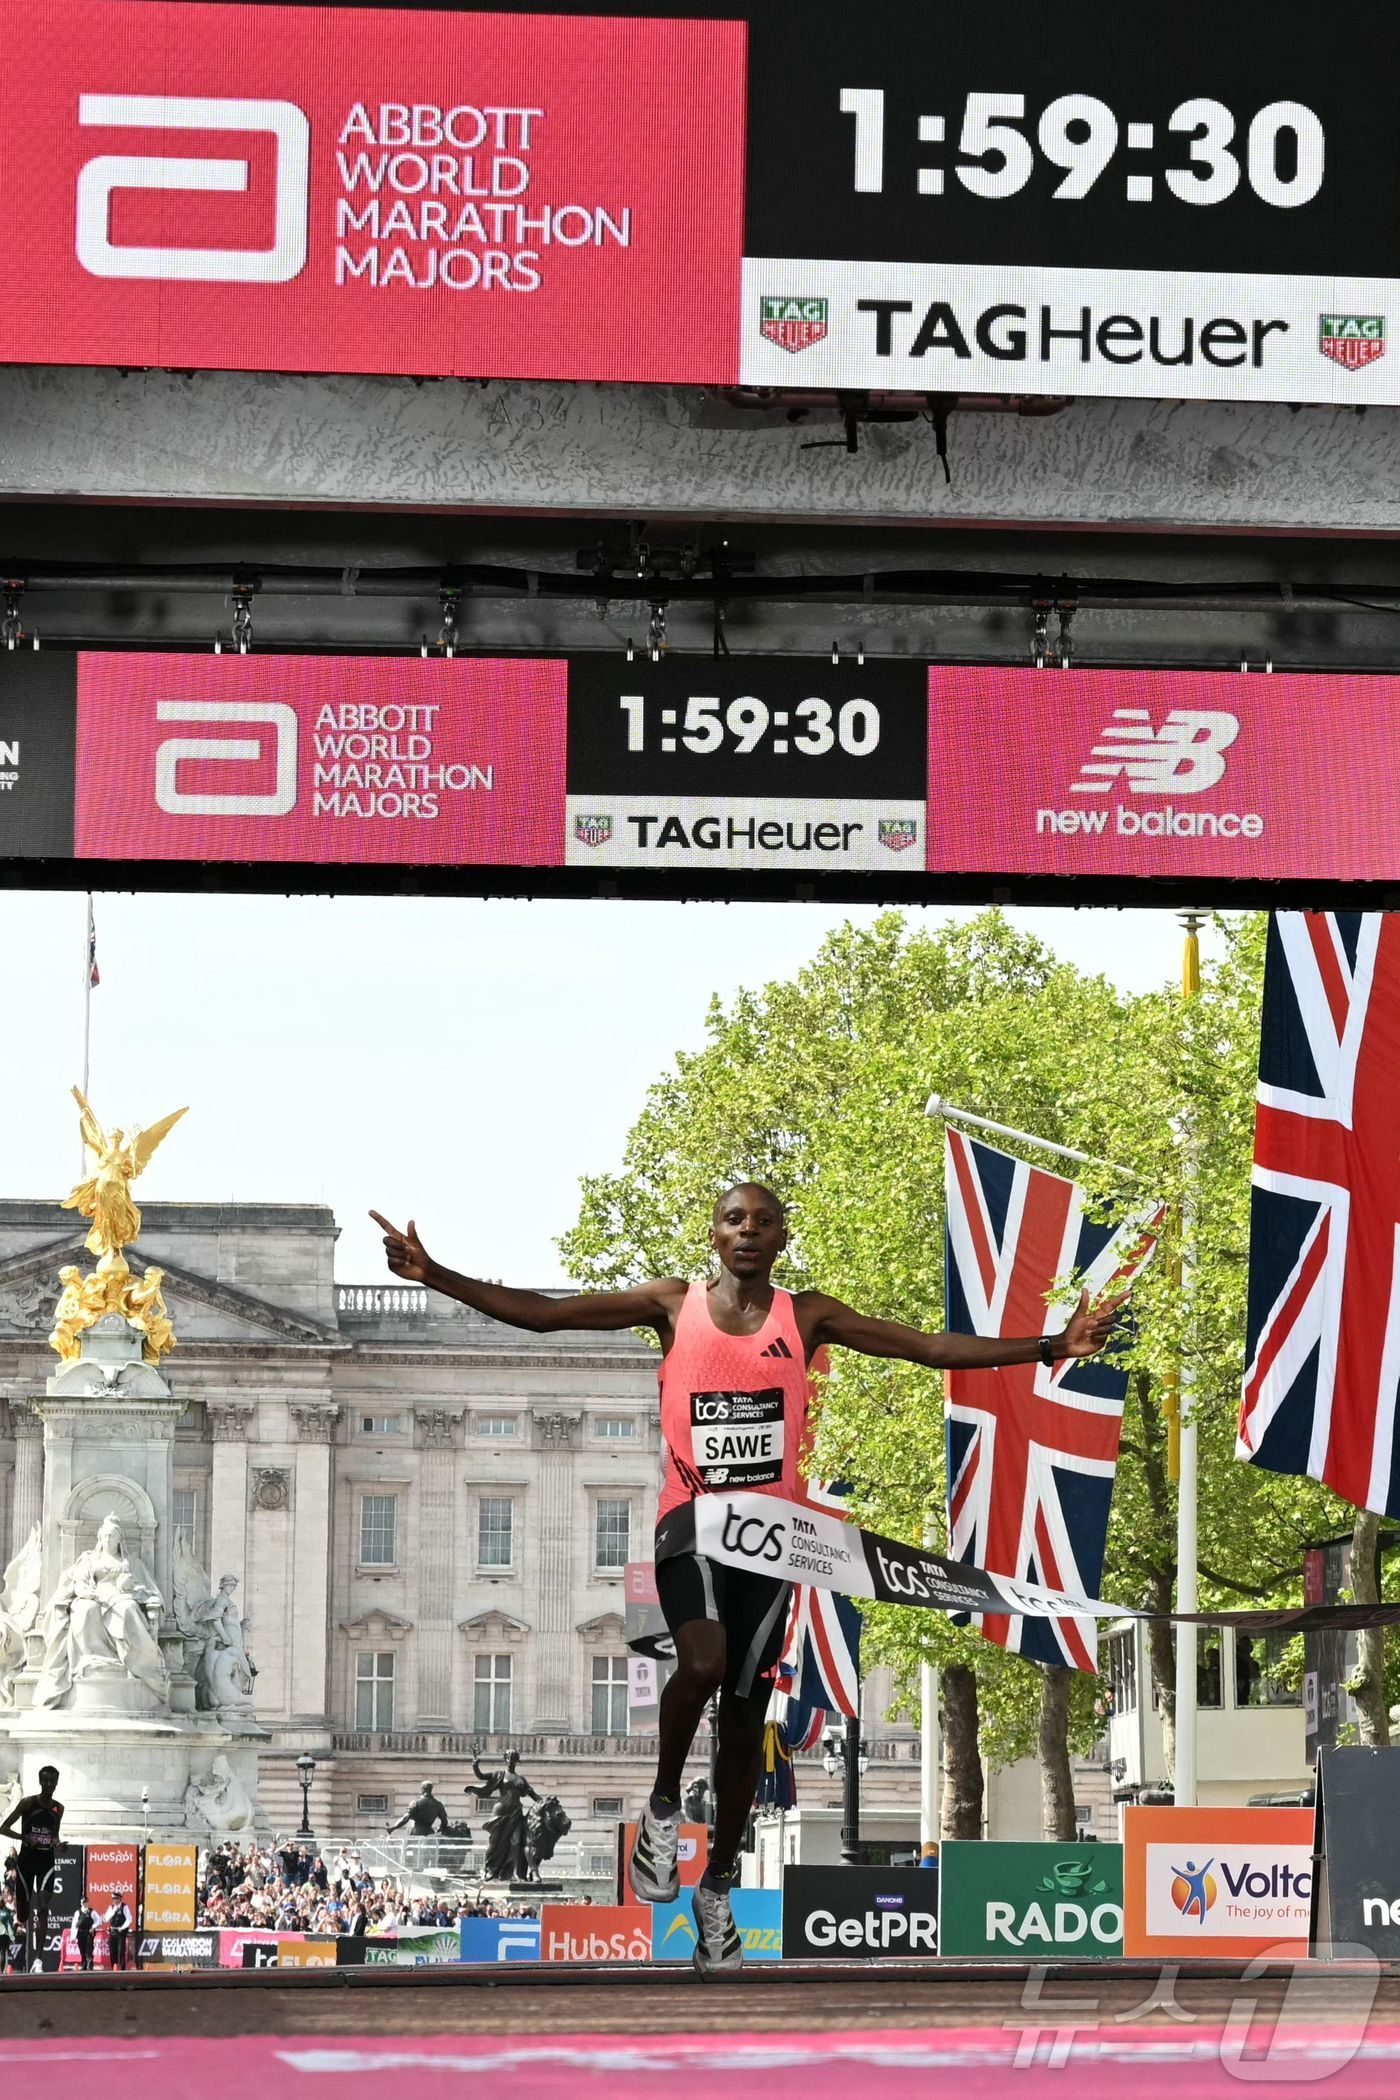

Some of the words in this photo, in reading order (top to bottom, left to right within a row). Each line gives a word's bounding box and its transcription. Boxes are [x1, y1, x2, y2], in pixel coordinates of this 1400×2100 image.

[337, 103, 544, 150] ABBOTT
[840, 87, 1325, 209] 1:59:30
[335, 151, 530, 197] WORLD
[334, 199, 632, 248] MARATHON
[334, 246, 542, 293] MAJORS
[768, 301, 819, 319] TAG
[1326, 319, 1379, 337] TAG
[1322, 340, 1381, 367] HEUER
[313, 704, 440, 732] ABBOTT
[620, 694, 881, 757] 1:59:30
[313, 733, 432, 761] WORLD
[313, 762, 494, 791] MARATHON
[313, 791, 440, 819] MAJORS
[1036, 808, 1110, 834] new
[1117, 804, 1265, 838] balance
[695, 1396, 729, 1420] tcs
[732, 1402, 779, 1411] CONSULTANCY
[732, 1411, 764, 1419] SERVICES
[705, 1434, 772, 1460] SAWE
[729, 1475, 745, 1483] new
[747, 1472, 775, 1482] balance
[722, 1503, 786, 1562] tcs
[791, 1517, 817, 1536] TATA
[791, 1535, 852, 1563] CONSULTANCY
[787, 1553, 833, 1576] SERVICES
[876, 1546, 930, 1598] tcs
[919, 1560, 948, 1578] TATA
[925, 1576, 990, 1600] CONSULTANCY
[89, 1850, 133, 1864] HubSpot
[148, 1855, 192, 1866] FLORA
[89, 1880, 133, 1894] HubSpot
[147, 1883, 191, 1895] FLORA
[146, 1911, 191, 1923] FLORA
[986, 1902, 1124, 1946] RADO
[1226, 1904, 1250, 1917] The
[1252, 1904, 1274, 1920] joy
[1277, 1904, 1292, 1917] of
[161, 1947, 213, 1957] MARATHON
